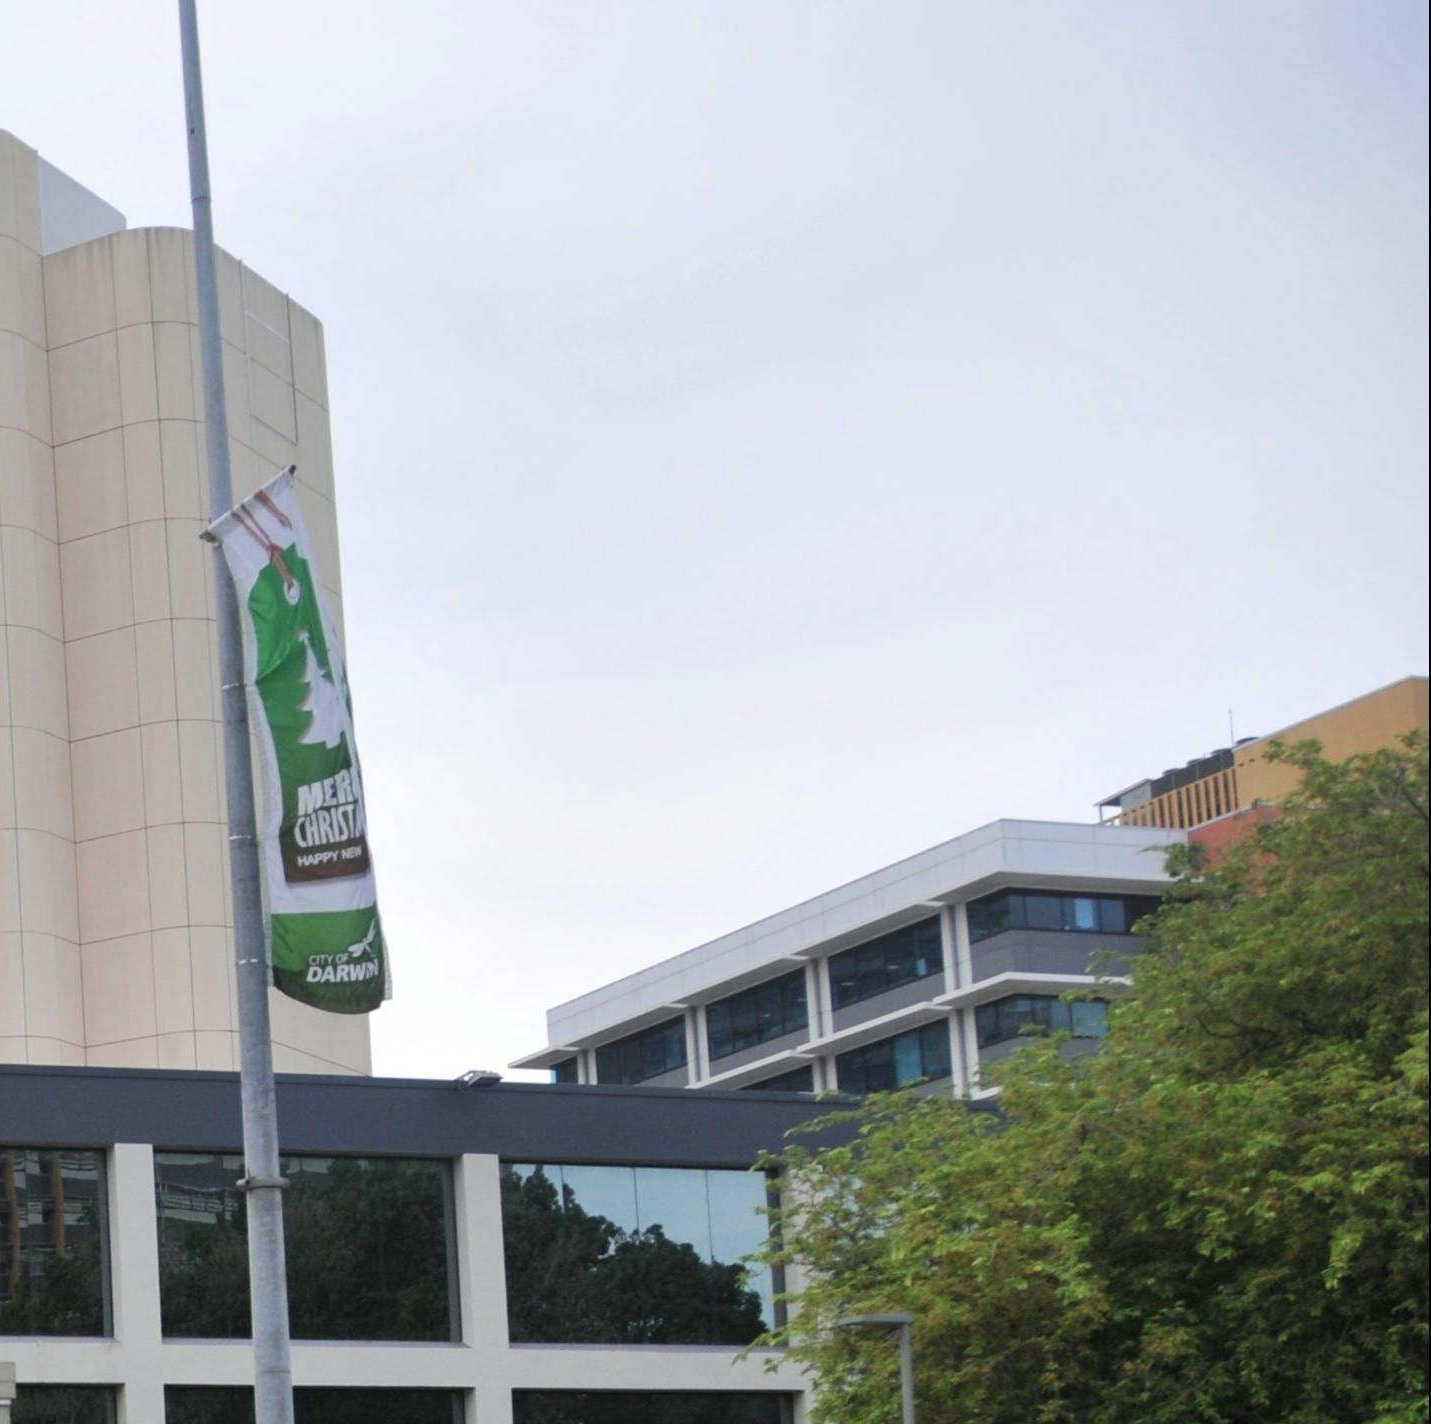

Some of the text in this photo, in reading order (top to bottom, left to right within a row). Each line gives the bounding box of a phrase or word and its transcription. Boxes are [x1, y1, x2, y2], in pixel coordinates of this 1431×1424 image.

[297, 768, 361, 816] MER
[297, 845, 363, 867] HAPPY NEW
[306, 958, 379, 983] DARWIN
[308, 953, 350, 965] CITY OF
